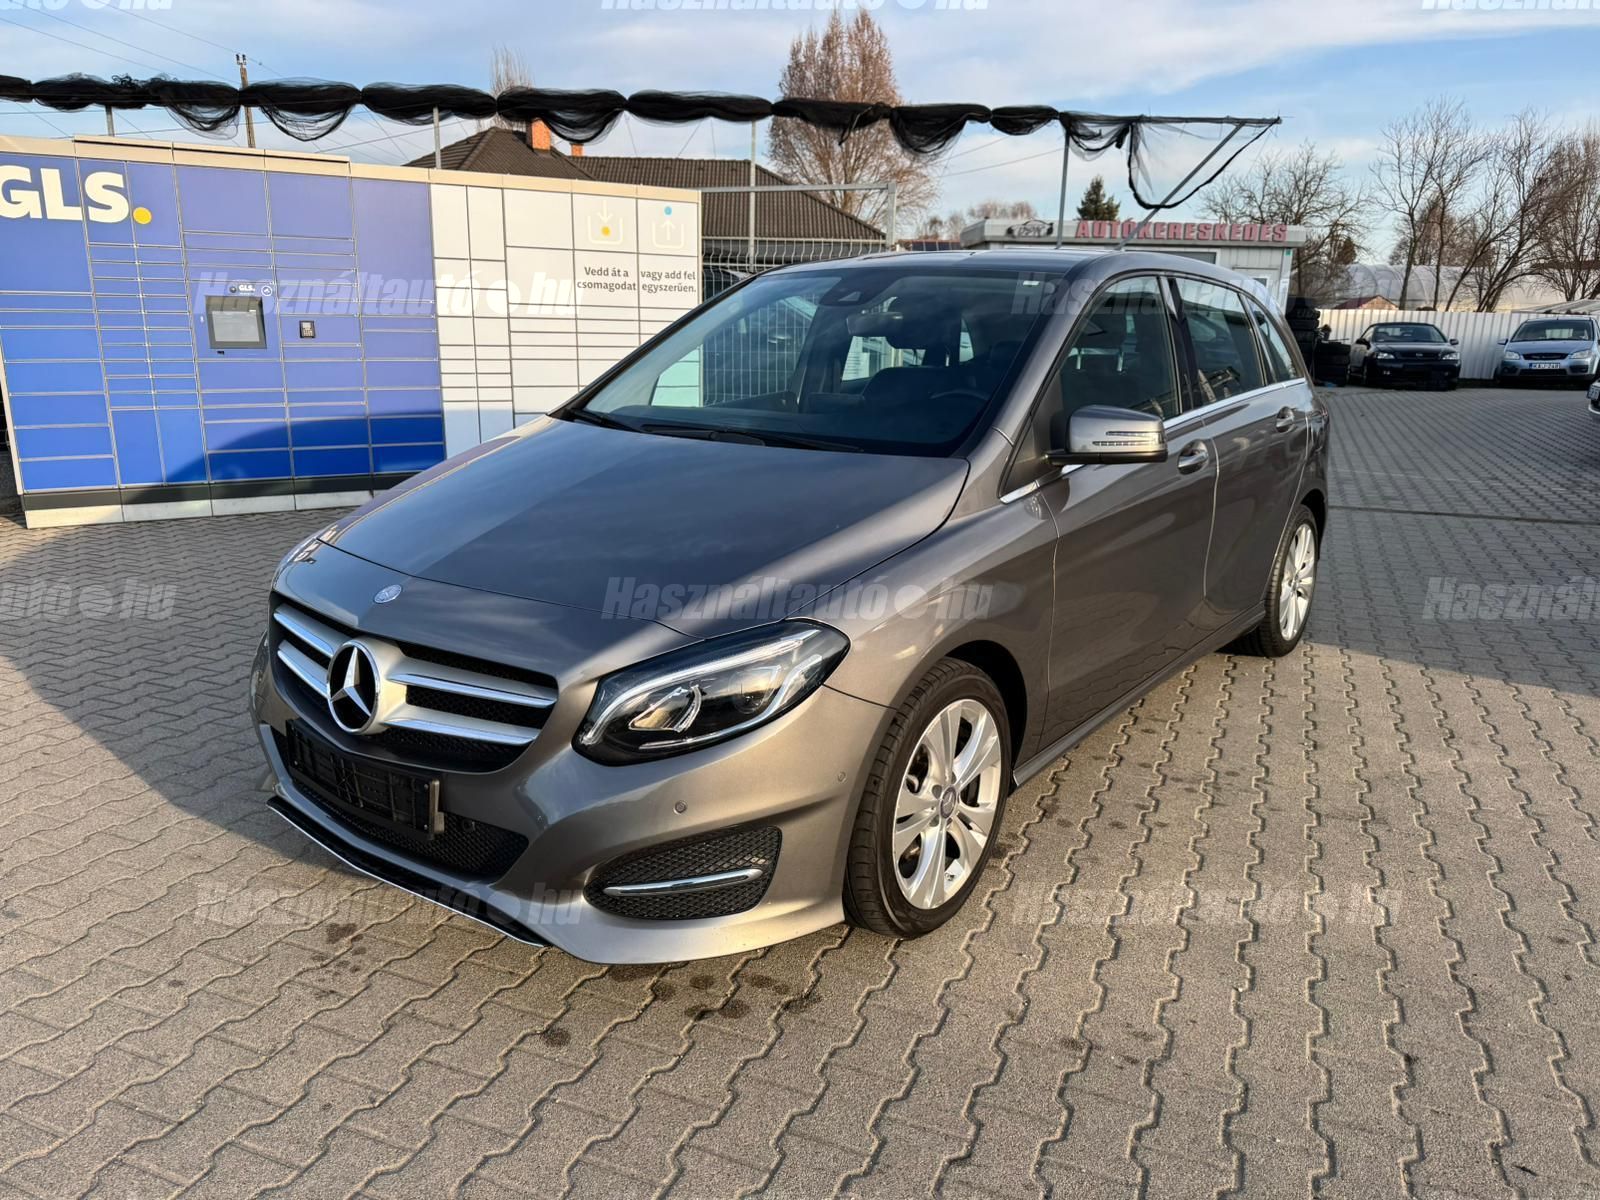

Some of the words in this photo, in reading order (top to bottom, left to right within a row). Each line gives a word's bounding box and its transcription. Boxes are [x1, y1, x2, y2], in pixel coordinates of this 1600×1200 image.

[584, 267, 609, 277] Vedd
[612, 268, 621, 277] át
[640, 271, 663, 281] vagy
[664, 271, 682, 280] add
[684, 271, 696, 280] fel
[577, 281, 636, 292] csomagodat
